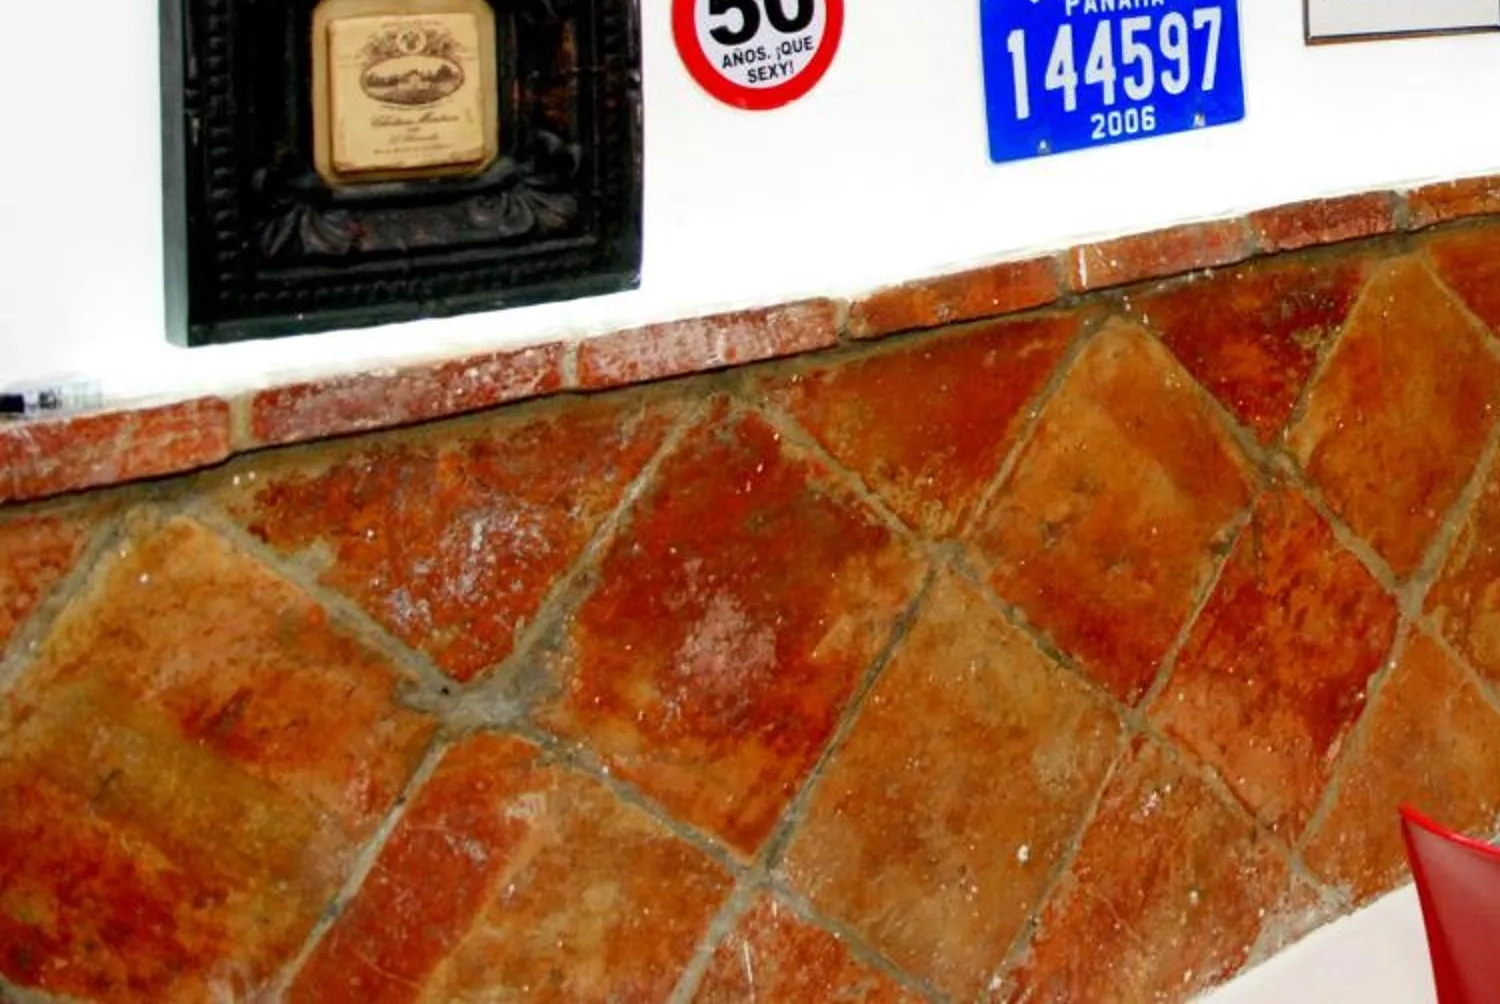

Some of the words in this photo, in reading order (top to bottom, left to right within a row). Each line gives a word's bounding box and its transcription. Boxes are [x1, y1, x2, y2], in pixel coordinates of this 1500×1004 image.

[722, 46, 771, 69] AÑOS.
[775, 36, 815, 61] ¡QUE
[1007, 5, 1222, 121] 144597
[747, 60, 795, 84] SEXY!
[1090, 105, 1157, 140] 2006
